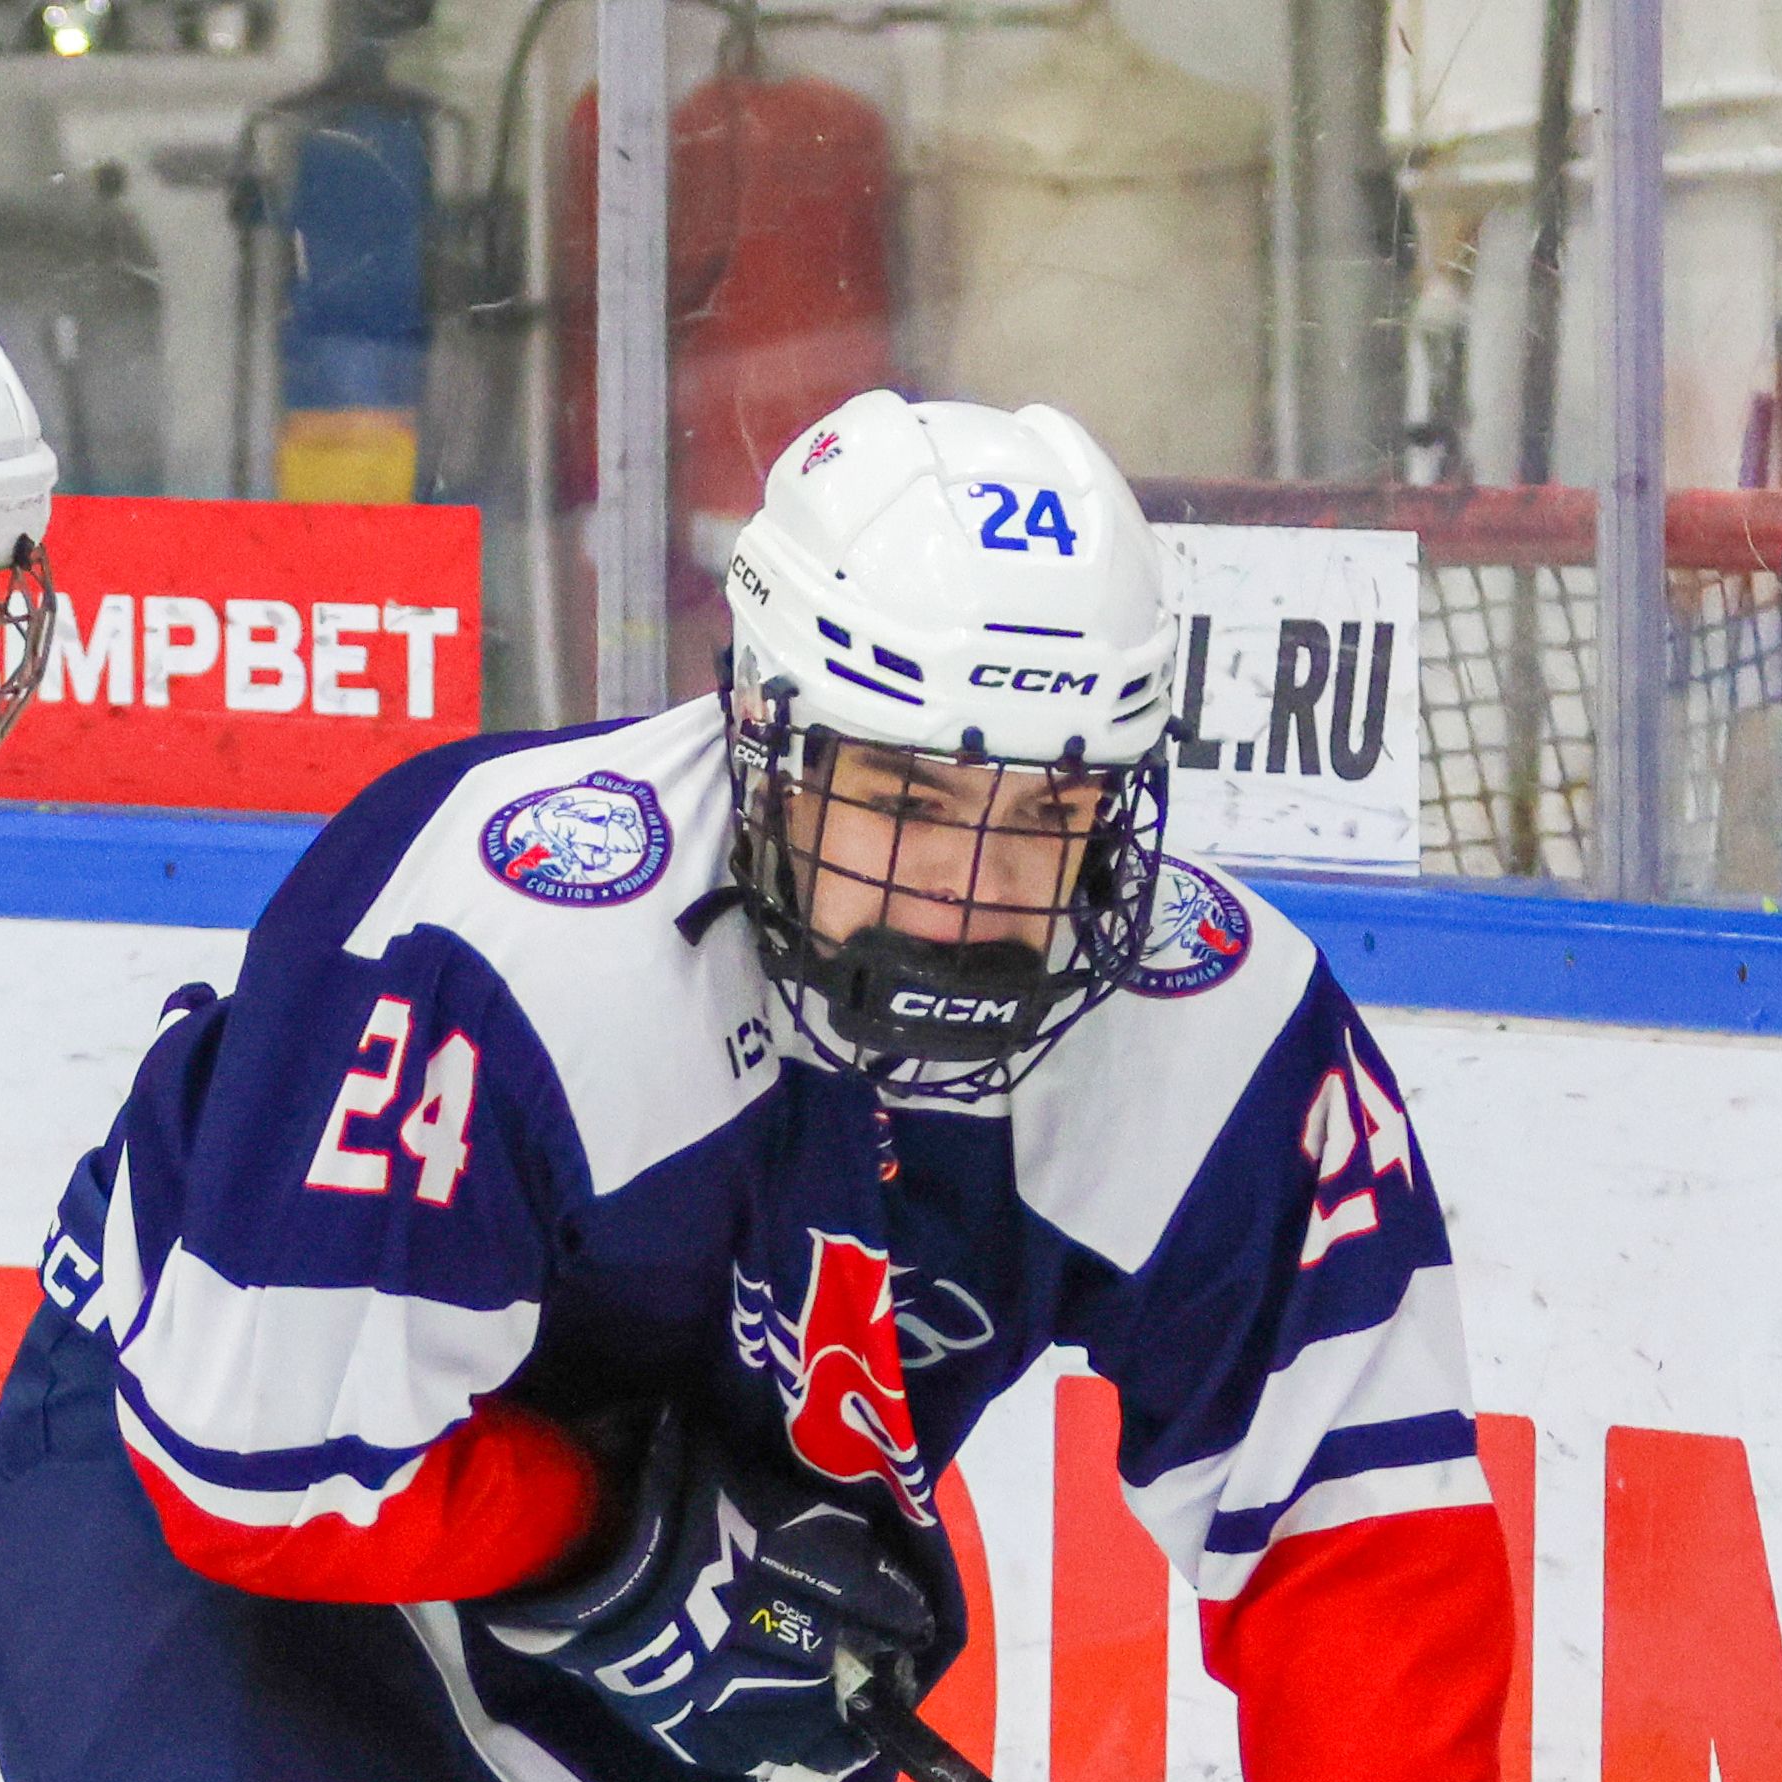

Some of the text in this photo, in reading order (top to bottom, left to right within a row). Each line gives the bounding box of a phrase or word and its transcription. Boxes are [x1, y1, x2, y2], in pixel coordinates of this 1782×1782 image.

[968, 482, 1078, 556] 24
[731, 555, 771, 606] CCM
[968, 664, 1099, 695] CCM
[1171, 614, 1395, 781] L.RU
[889, 991, 1020, 1023] CCM
[305, 994, 480, 1209] 24
[1299, 1029, 1415, 1270] 24
